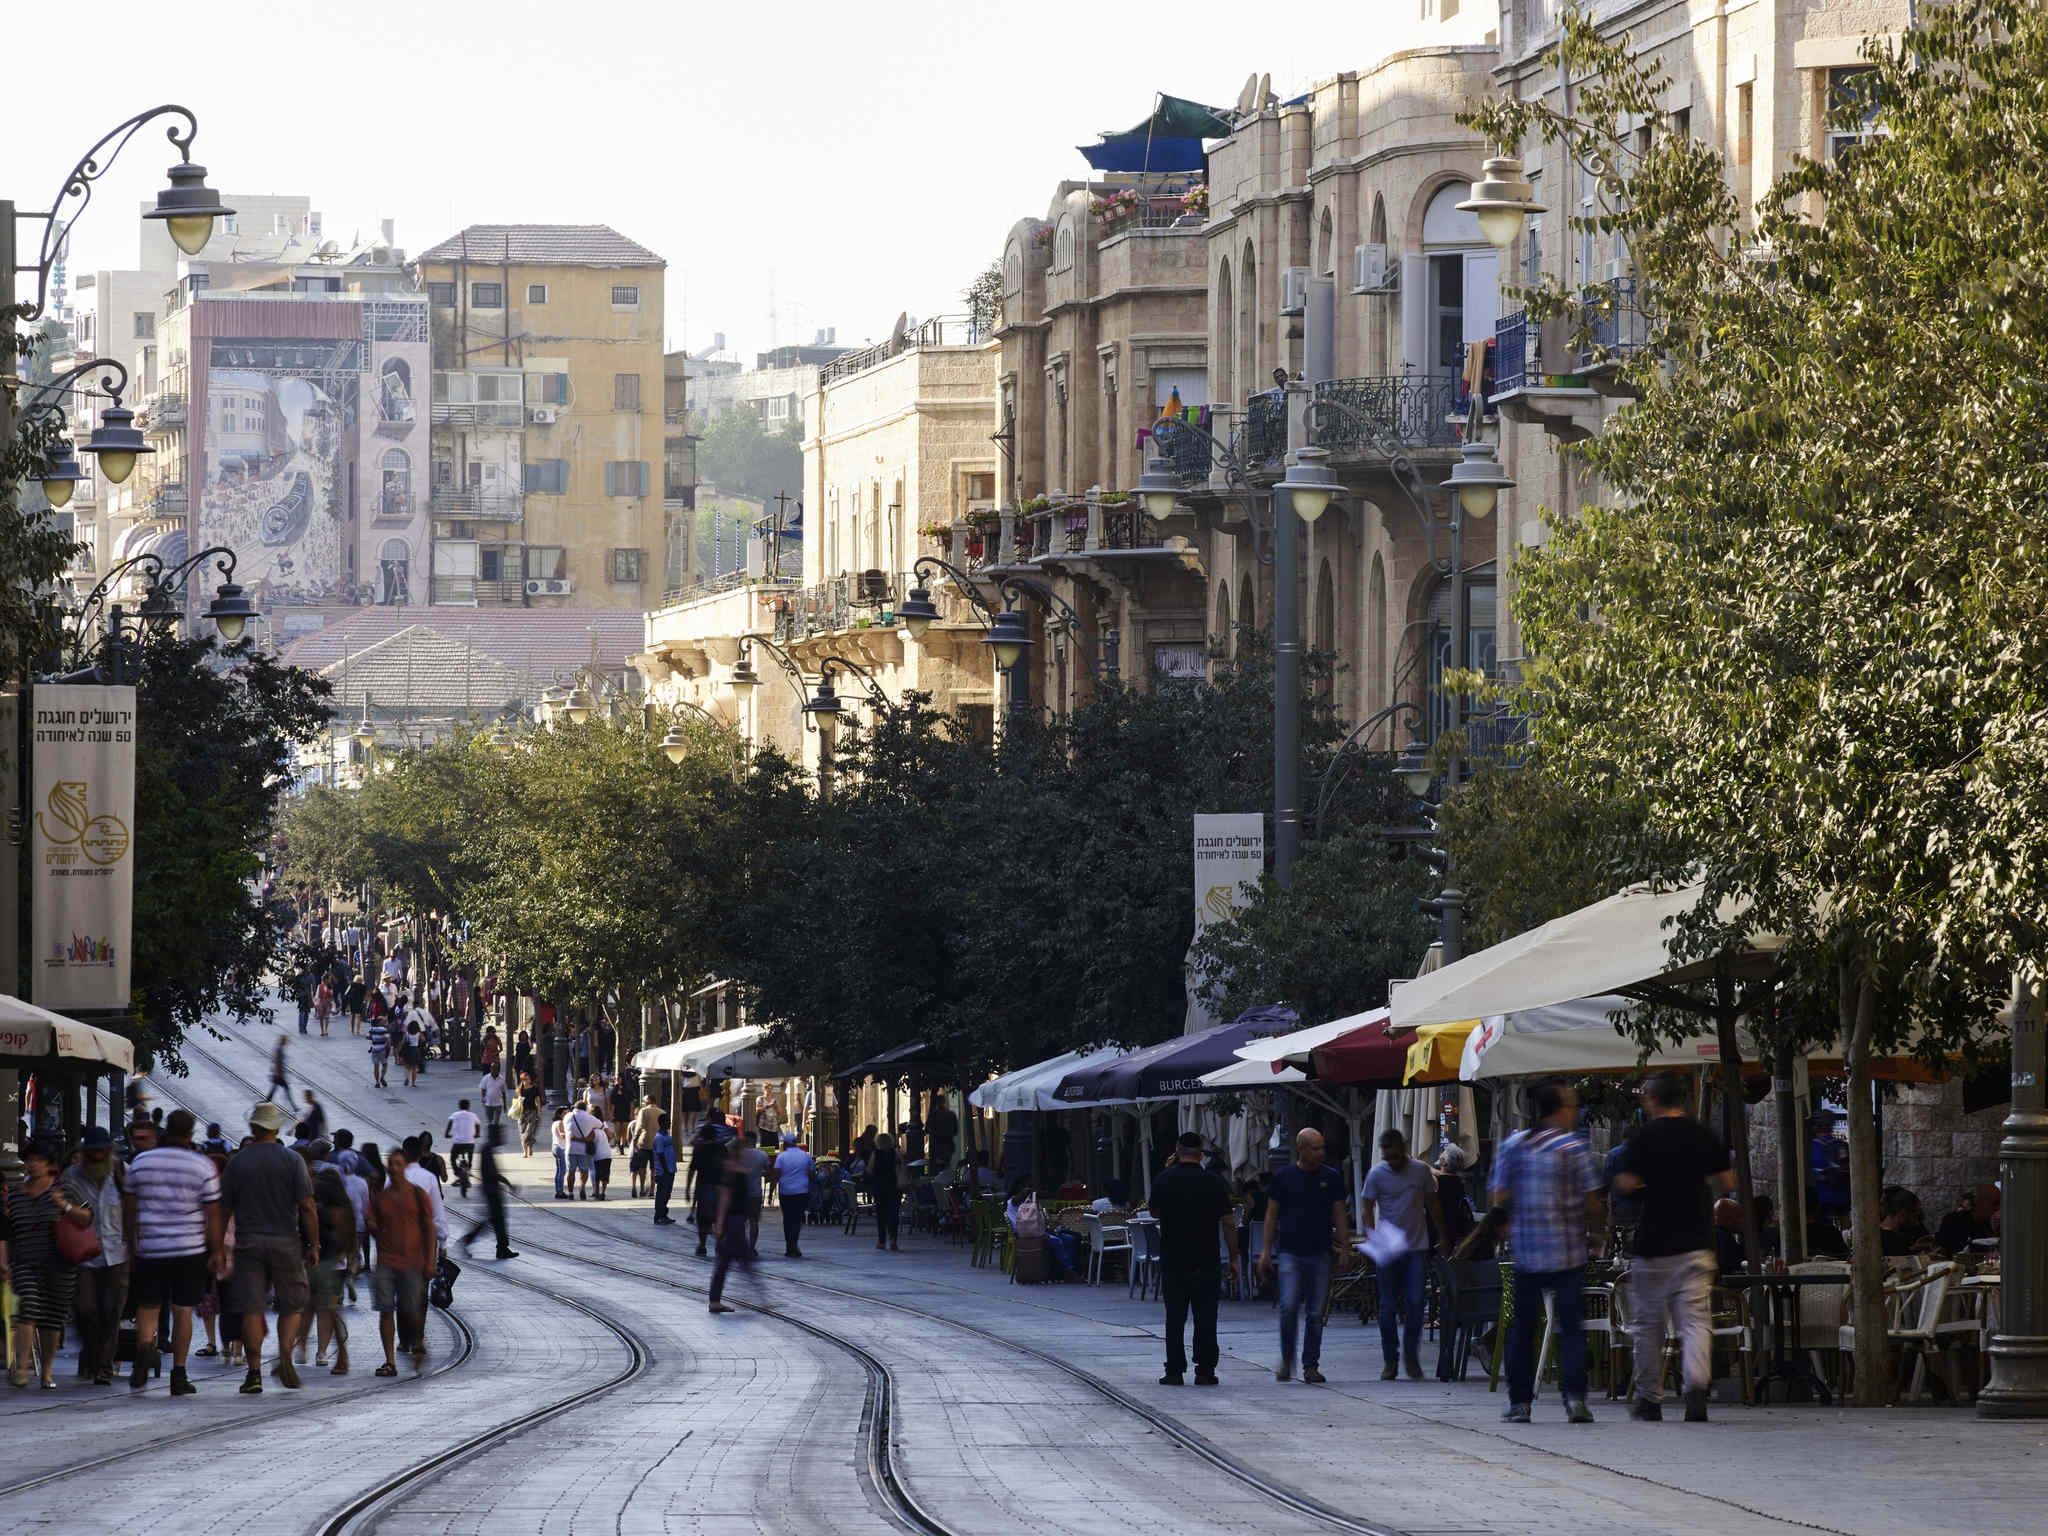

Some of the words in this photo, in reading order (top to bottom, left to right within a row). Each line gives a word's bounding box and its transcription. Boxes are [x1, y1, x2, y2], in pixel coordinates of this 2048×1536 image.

[37, 710, 76, 725] חוגגת
[80, 709, 132, 725] ירושלים
[36, 728, 85, 743] לאיחודה
[88, 730, 112, 743] שנה
[115, 730, 131, 743] 50
[1226, 835, 1262, 848] ירושלים
